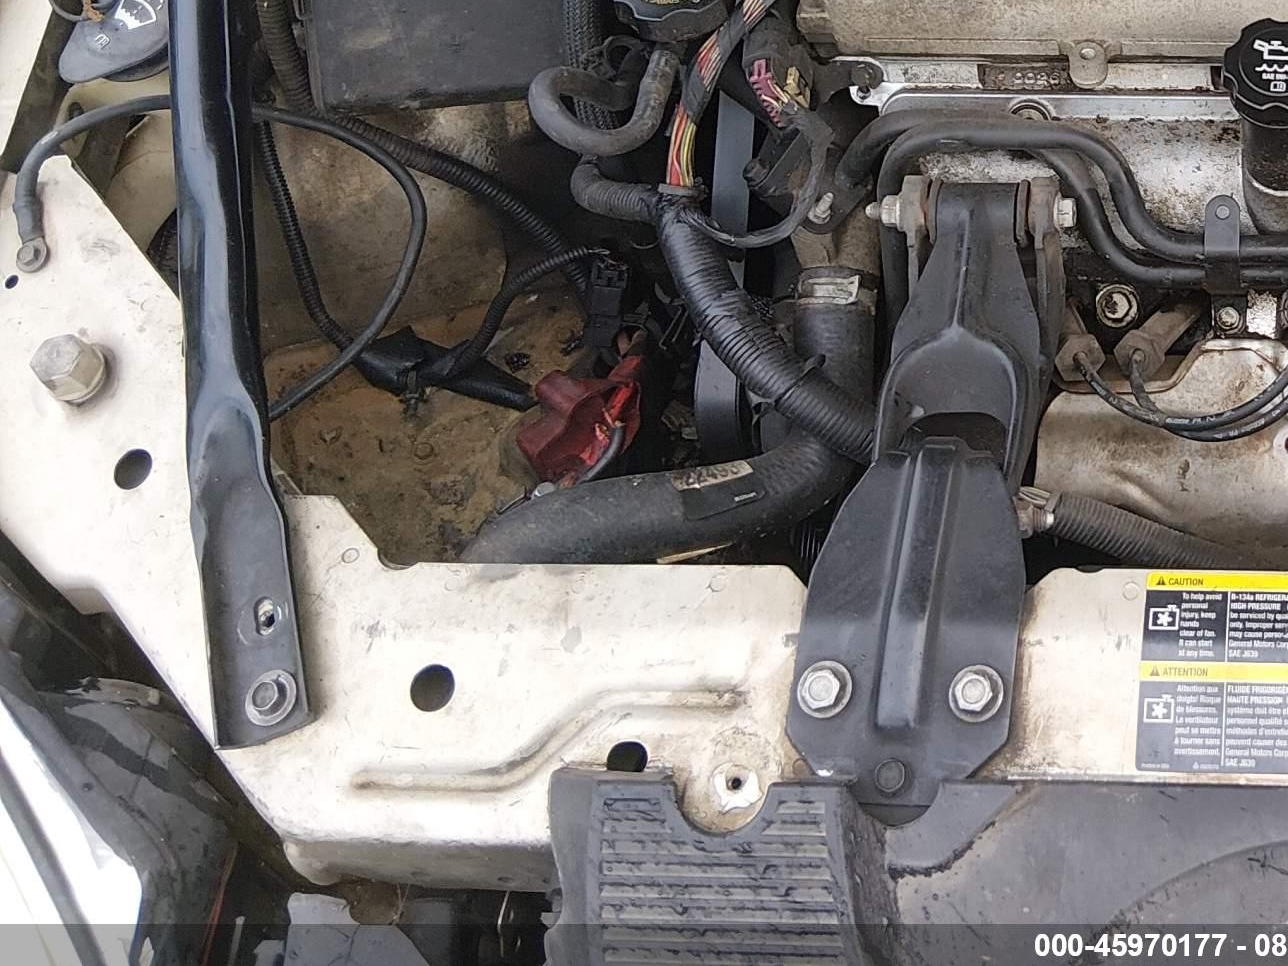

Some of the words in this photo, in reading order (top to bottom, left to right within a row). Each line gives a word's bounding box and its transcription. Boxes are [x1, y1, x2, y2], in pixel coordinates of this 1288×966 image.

[1169, 578, 1203, 586] CAUTION
[1191, 593, 1204, 601] help
[1231, 593, 1253, 601] R-134a
[1231, 602, 1246, 610] HIGH
[1254, 640, 1275, 648] Motors
[1229, 649, 1241, 657] SAE
[1163, 668, 1208, 677] ATTENTION
[1228, 685, 1250, 693] FLUIDE
[1227, 695, 1249, 704] HAUTE
[1250, 696, 1283, 704] PRESSION
[1225, 748, 1249, 756] General
[1251, 748, 1272, 756] Motors
